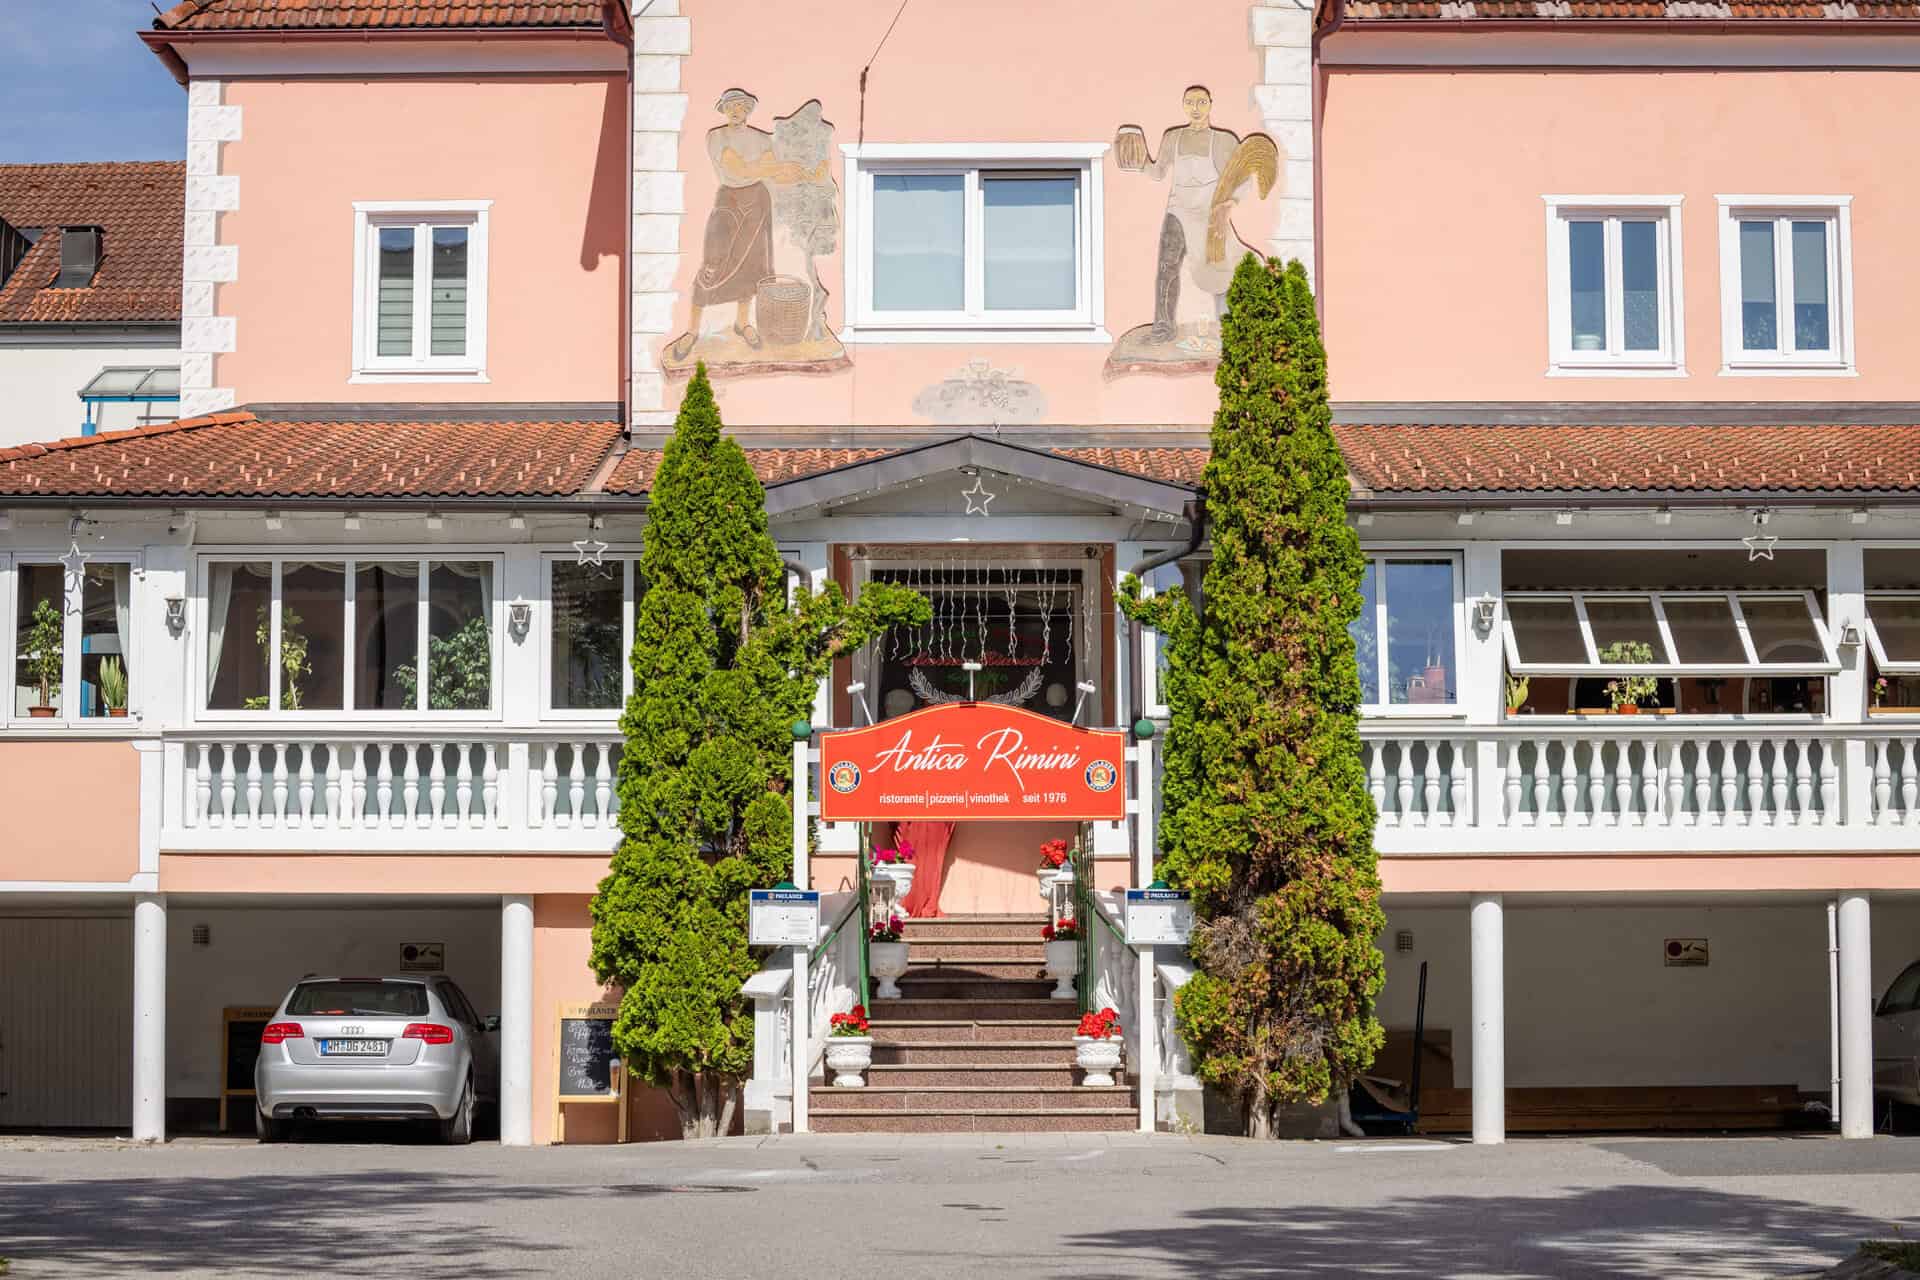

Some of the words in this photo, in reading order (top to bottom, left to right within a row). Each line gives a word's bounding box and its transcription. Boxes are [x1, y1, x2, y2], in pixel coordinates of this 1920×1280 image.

[867, 729, 968, 773] Antica
[976, 727, 1081, 791] Rimini
[879, 793, 924, 804] ristorante
[929, 793, 965, 806] pizzeria
[969, 792, 1009, 804] vinothek
[1022, 792, 1040, 803] seit
[1043, 792, 1066, 803] 1976
